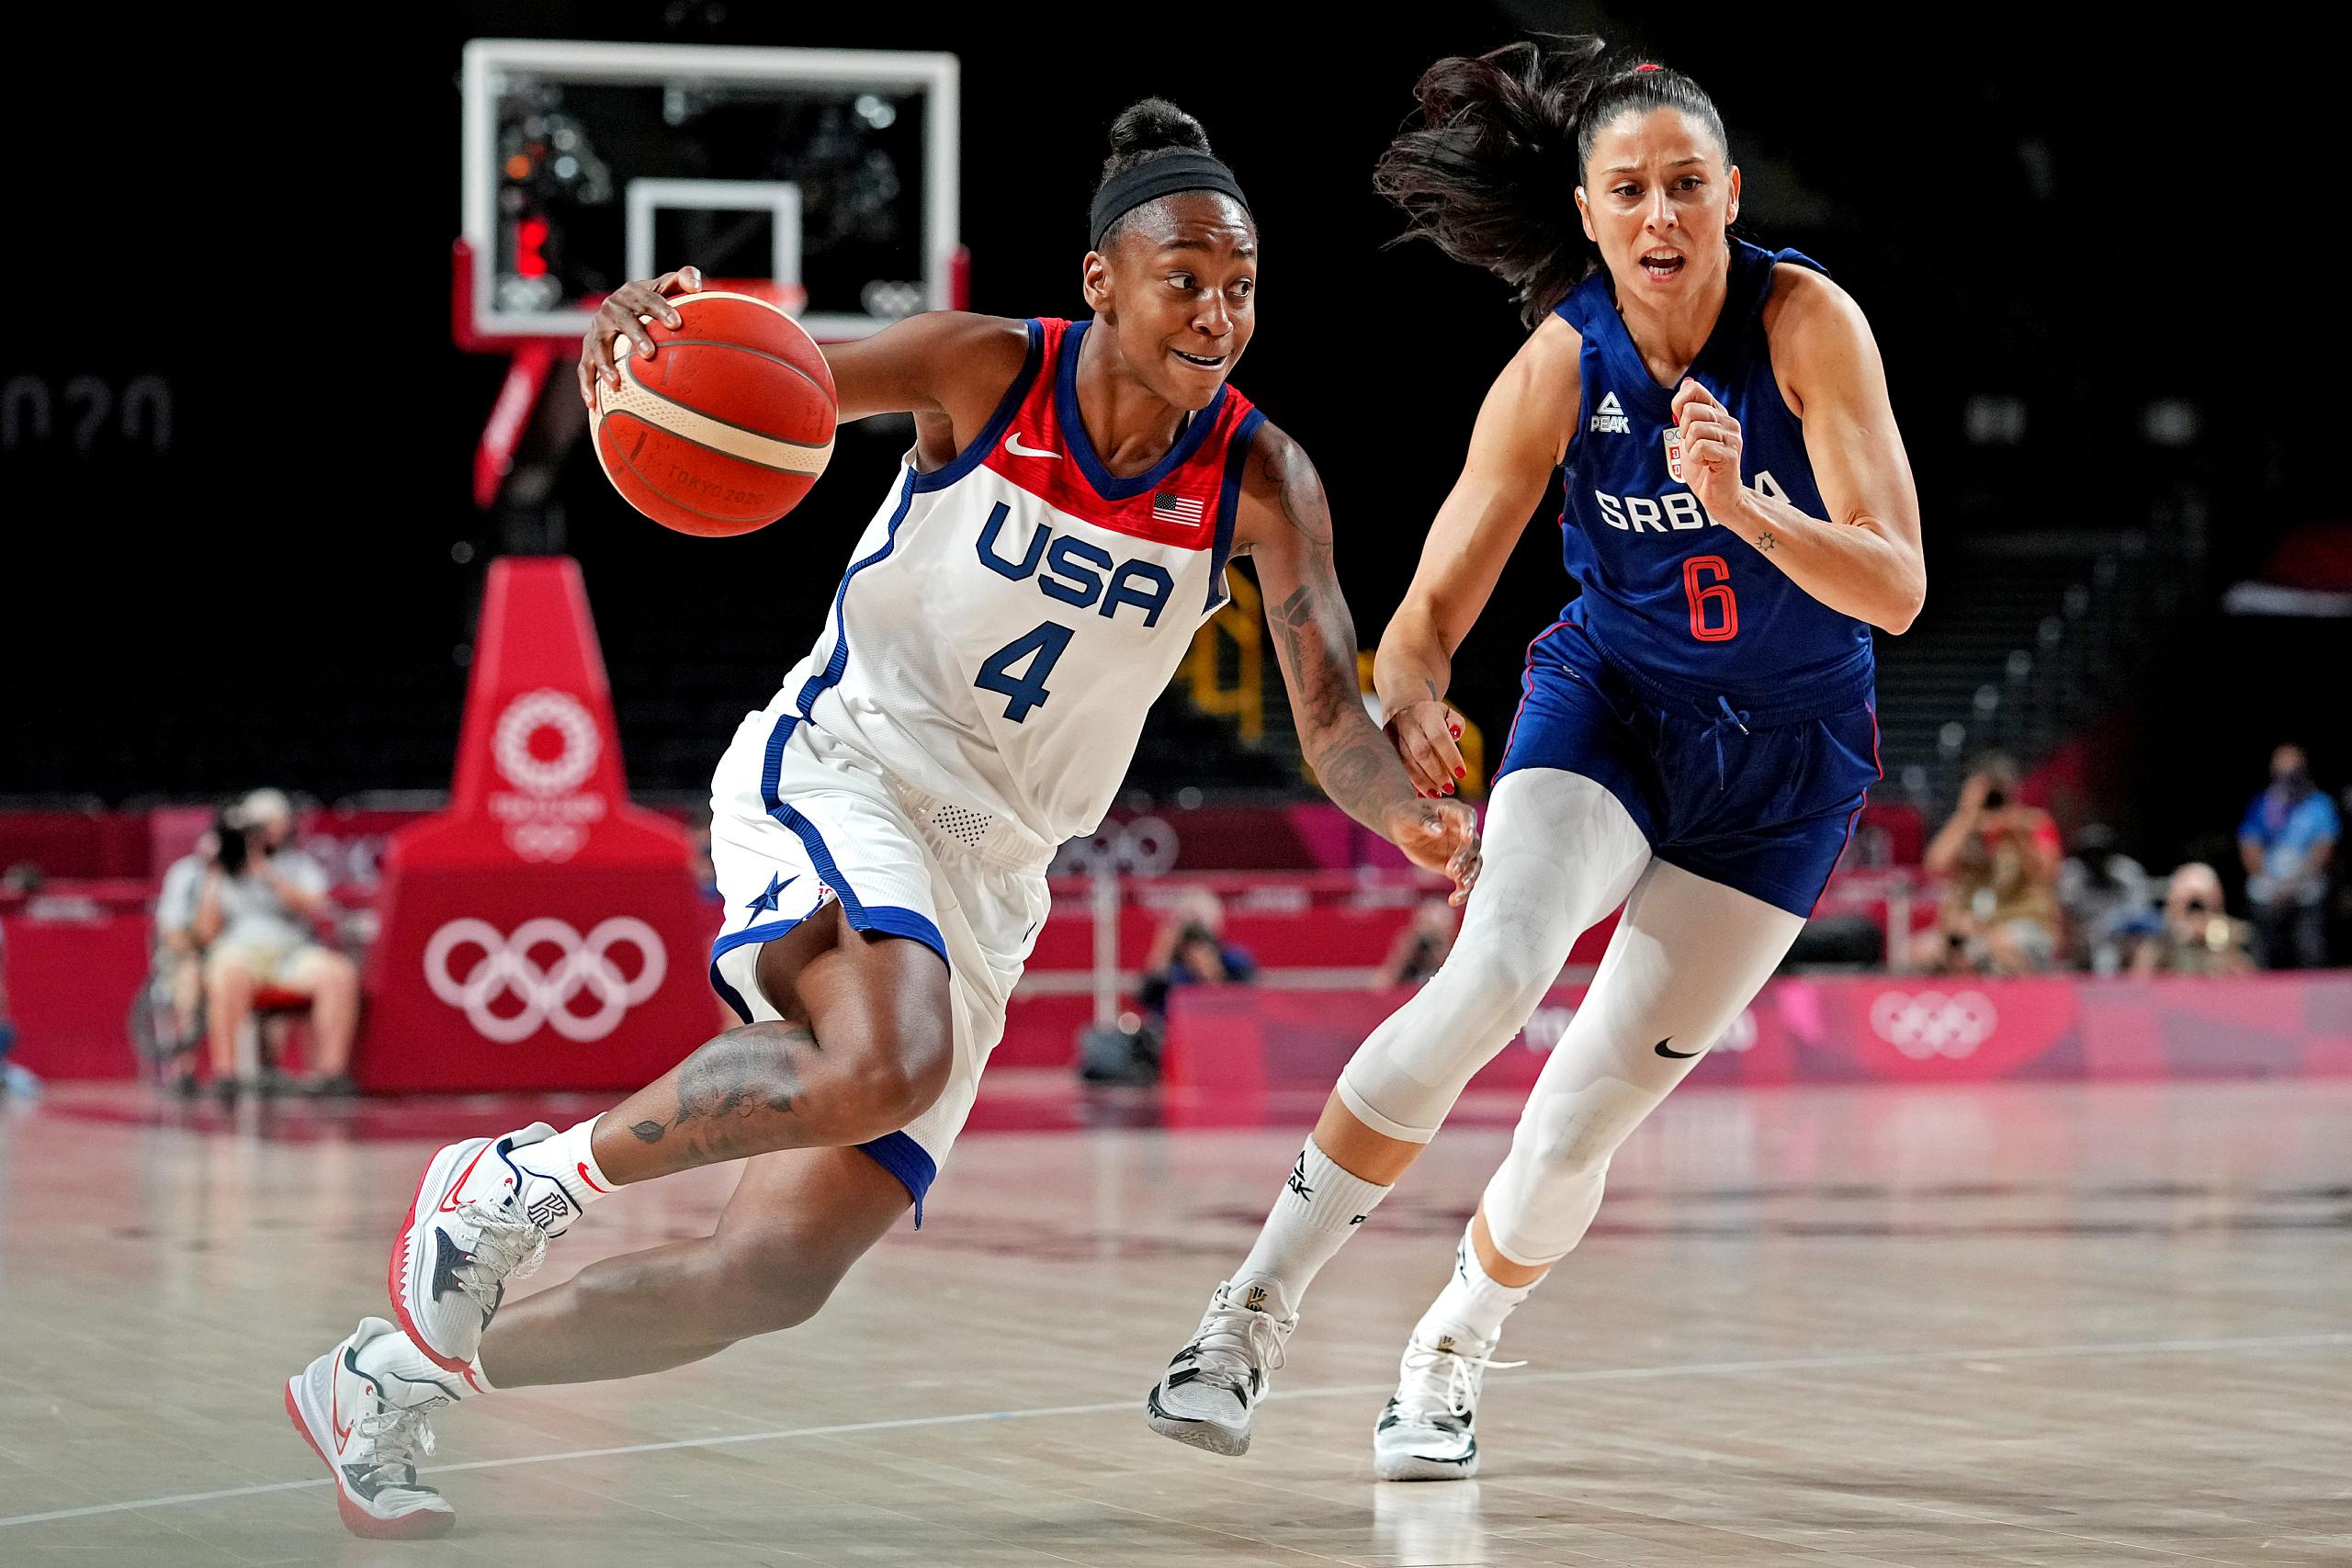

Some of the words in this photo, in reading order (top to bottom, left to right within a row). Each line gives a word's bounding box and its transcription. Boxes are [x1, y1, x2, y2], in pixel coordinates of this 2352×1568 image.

[1589, 414, 1631, 434] PEAK
[669, 466, 723, 497] TOKYO
[1594, 470, 1792, 533] SRBA
[975, 500, 1175, 628] USA
[1682, 555, 1739, 642] 6
[973, 620, 1076, 724] 4
